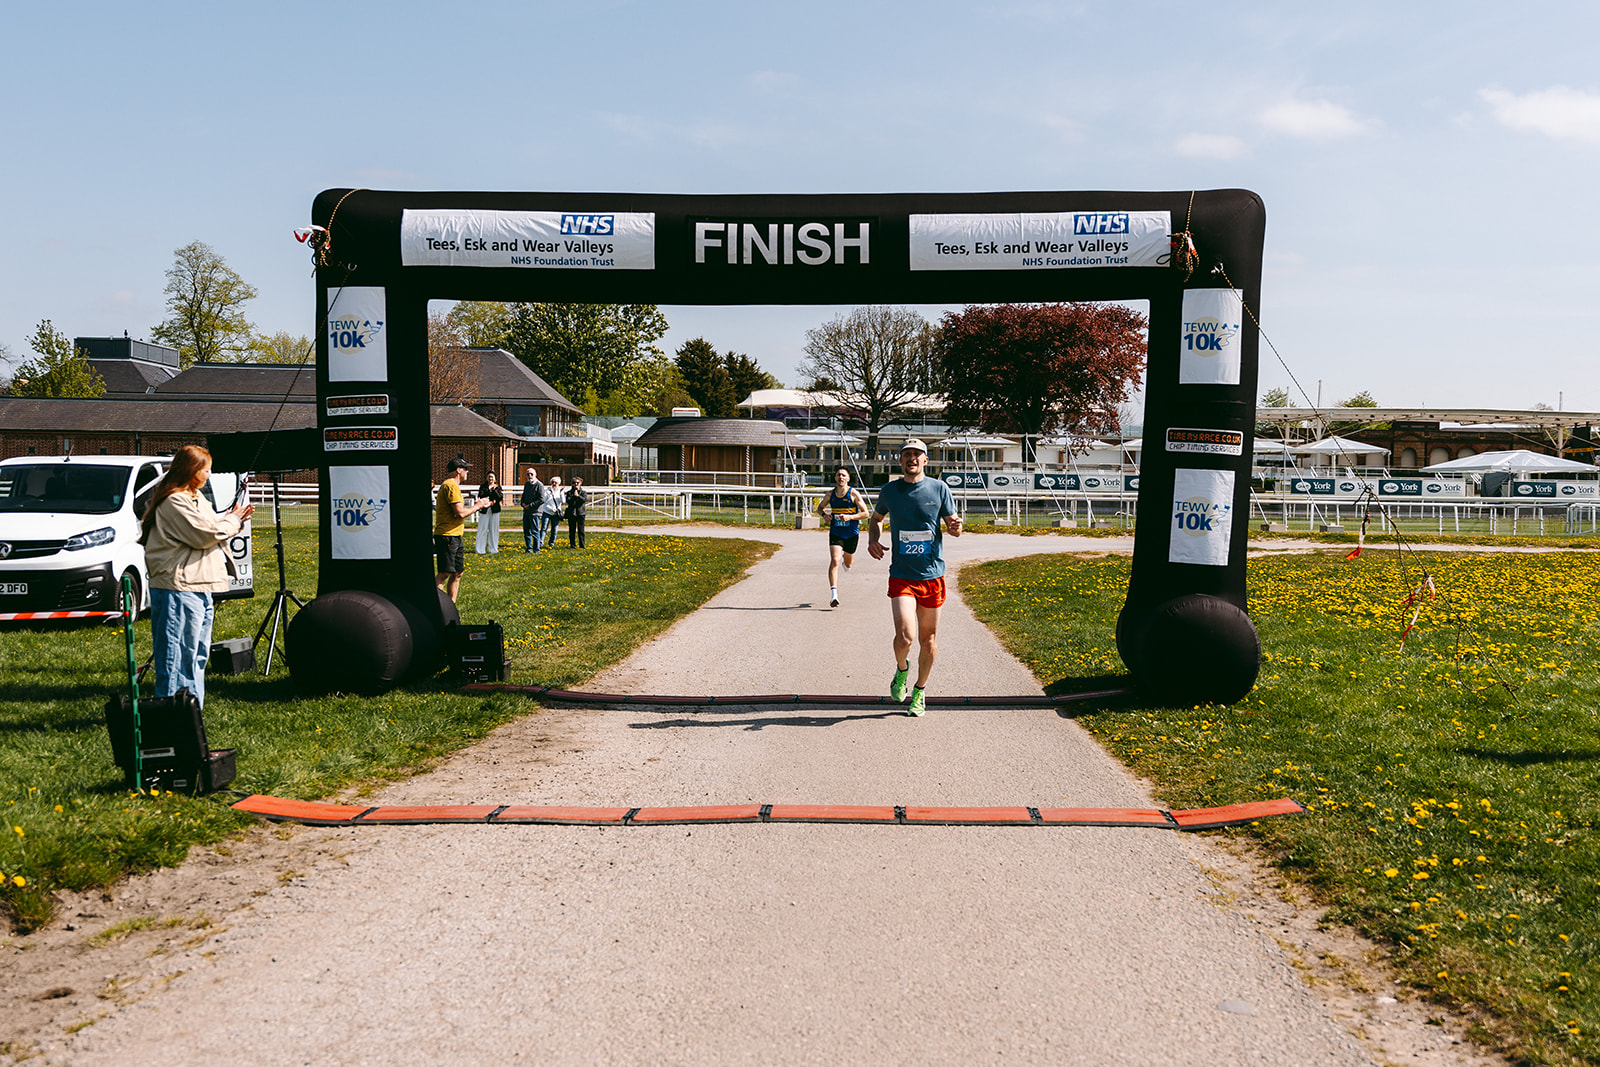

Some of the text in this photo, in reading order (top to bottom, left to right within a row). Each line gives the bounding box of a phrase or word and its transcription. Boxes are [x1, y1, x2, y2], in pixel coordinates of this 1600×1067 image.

[562, 216, 612, 234] NHS
[1076, 215, 1126, 233] NHS
[426, 238, 613, 256] Tees, Esk and Wear Valleys
[695, 222, 870, 265] FINISH
[935, 239, 1129, 255] Tees, Esk and Wear Valleys
[511, 256, 614, 266] NHS Foundation Trust
[1022, 256, 1128, 266] NHS Foundation Trust
[329, 320, 360, 330] TEWV
[1184, 322, 1219, 332] TEWV
[330, 331, 366, 348] 10k
[1184, 333, 1222, 351] 10k
[361, 441, 395, 449] SERVICES
[1211, 444, 1240, 454] SERVICES
[1057, 477, 1076, 485] York
[1102, 478, 1120, 486] York
[1400, 483, 1418, 491] York
[1535, 485, 1552, 493] York
[333, 499, 363, 508] TEWV
[1175, 501, 1210, 512] TEWV
[333, 509, 369, 526] 10k
[1175, 512, 1212, 531] 10k
[905, 544, 925, 554] 226
[7, 584, 27, 593] DFO
